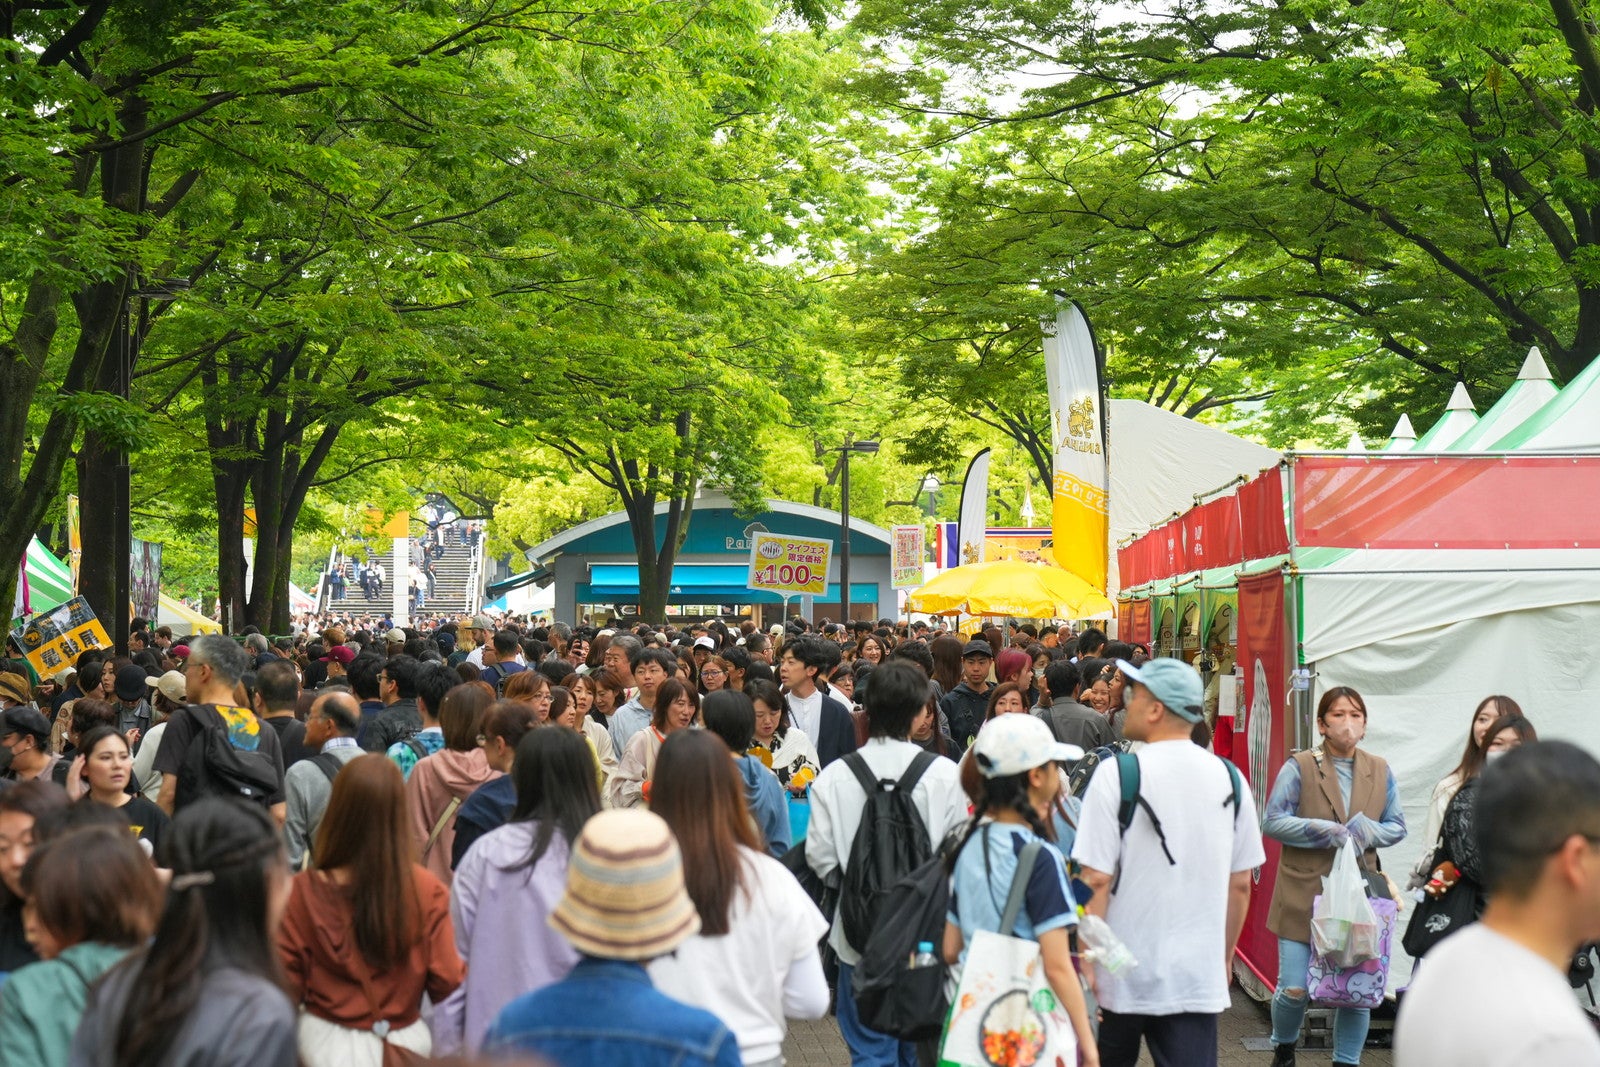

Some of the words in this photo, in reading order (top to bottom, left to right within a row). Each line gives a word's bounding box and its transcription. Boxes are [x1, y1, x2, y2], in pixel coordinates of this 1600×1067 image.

[726, 536, 752, 549] Par
[787, 544, 826, 554] タイフェス
[788, 553, 822, 564] 限定価格
[40, 628, 100, 669] 最後尾
